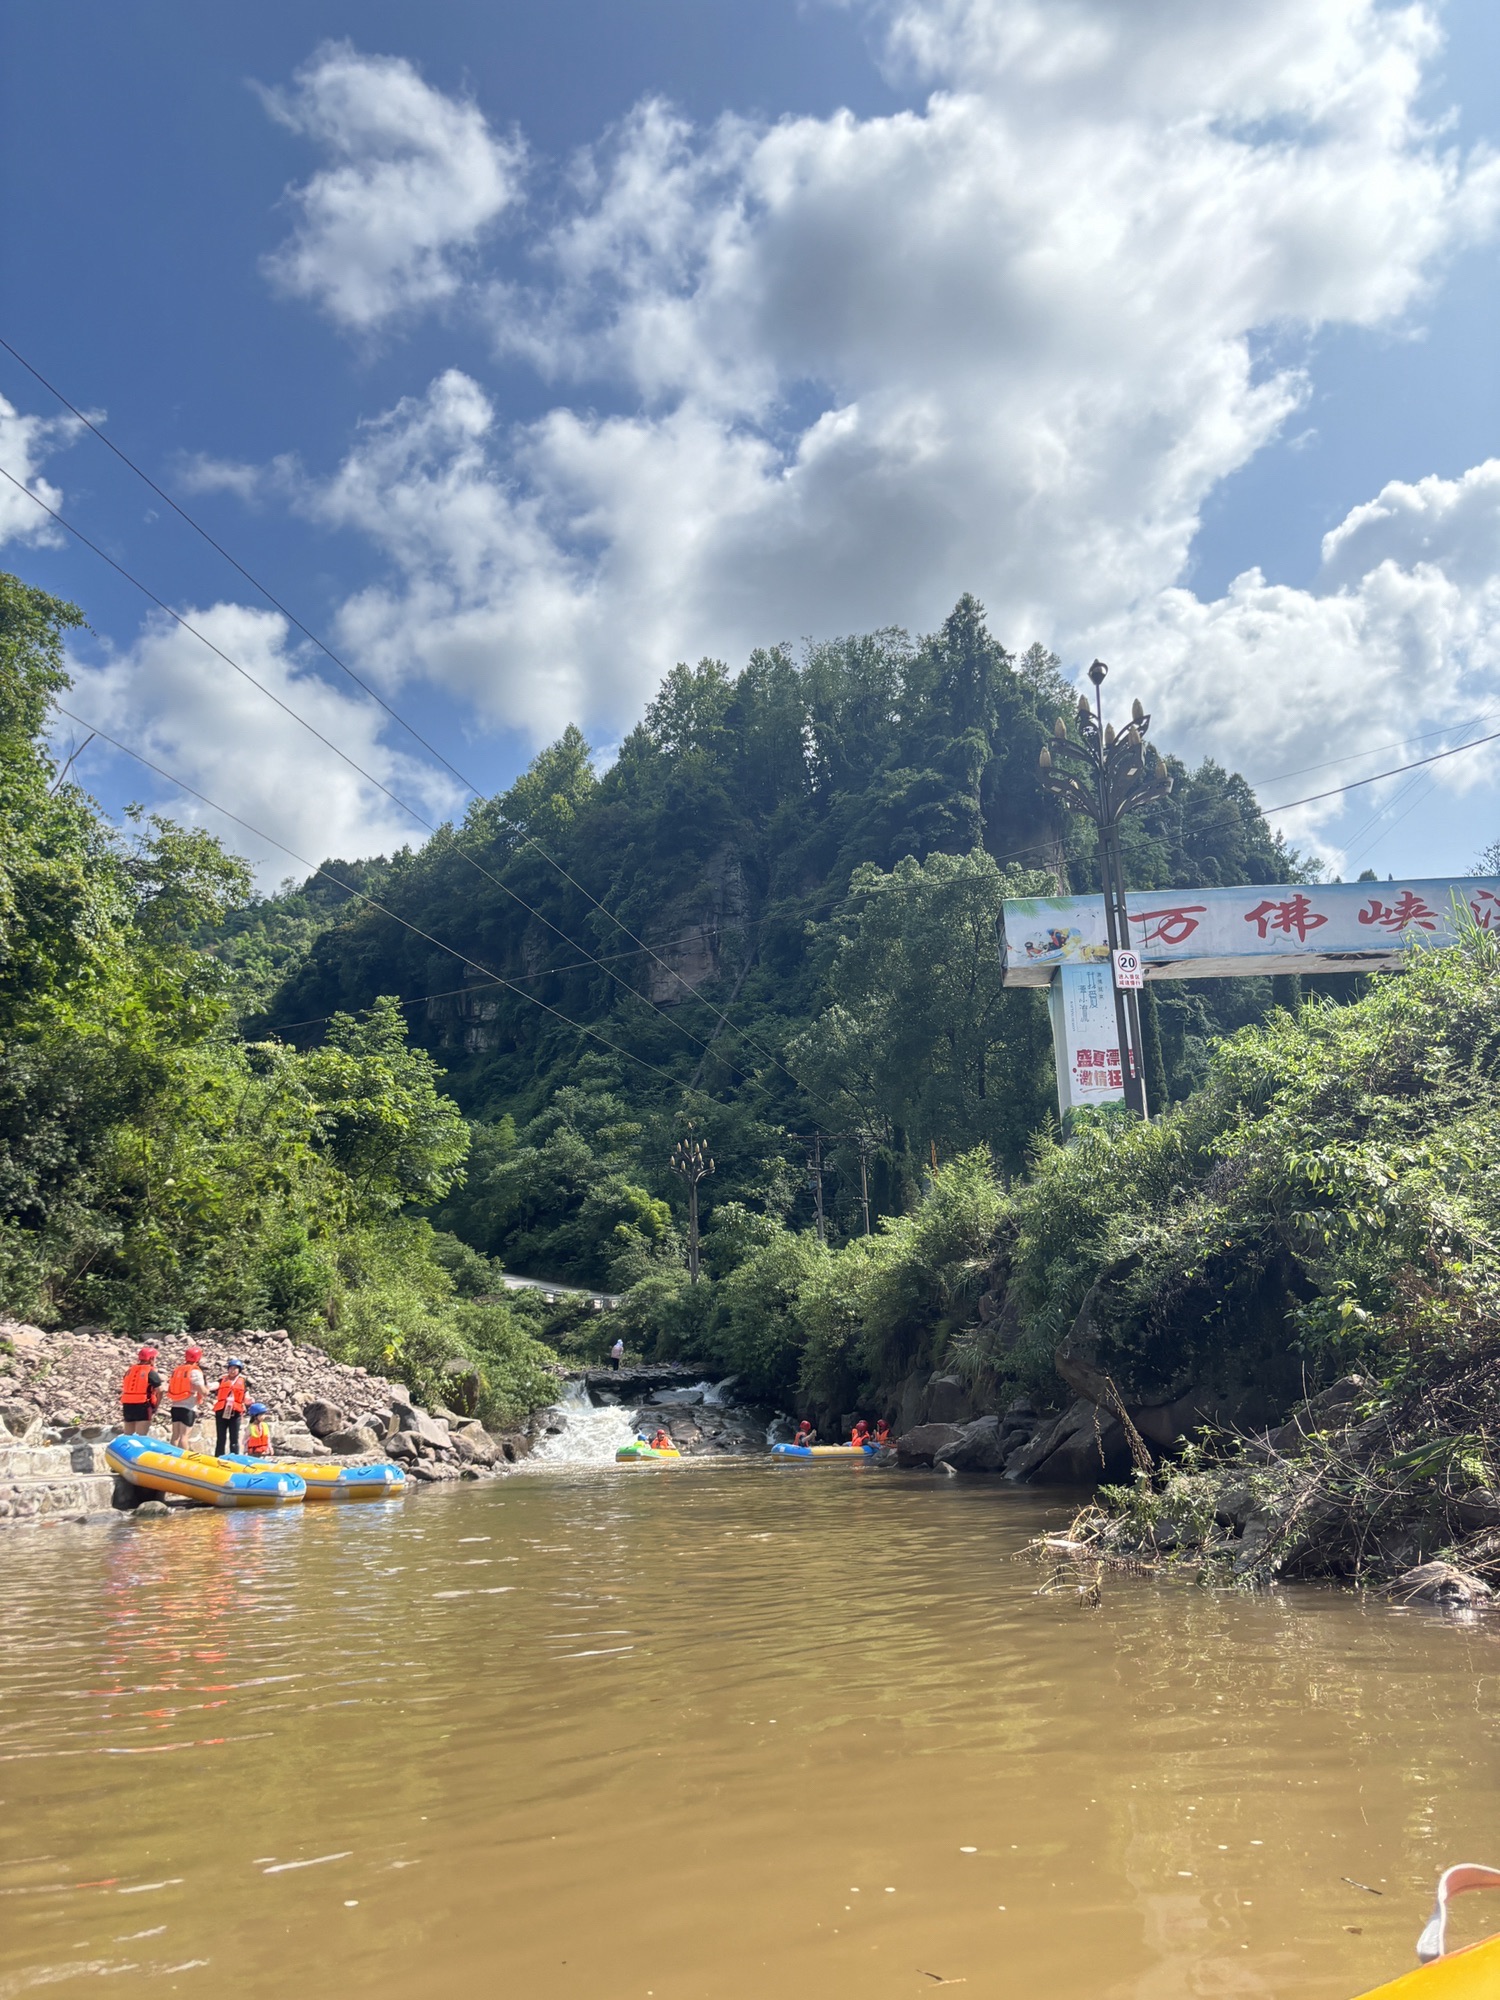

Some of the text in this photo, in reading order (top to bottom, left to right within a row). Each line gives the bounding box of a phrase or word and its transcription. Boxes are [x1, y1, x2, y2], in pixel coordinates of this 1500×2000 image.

[1120, 957, 1136, 968] 20
[1079, 1069, 1136, 1087] 激情狂
